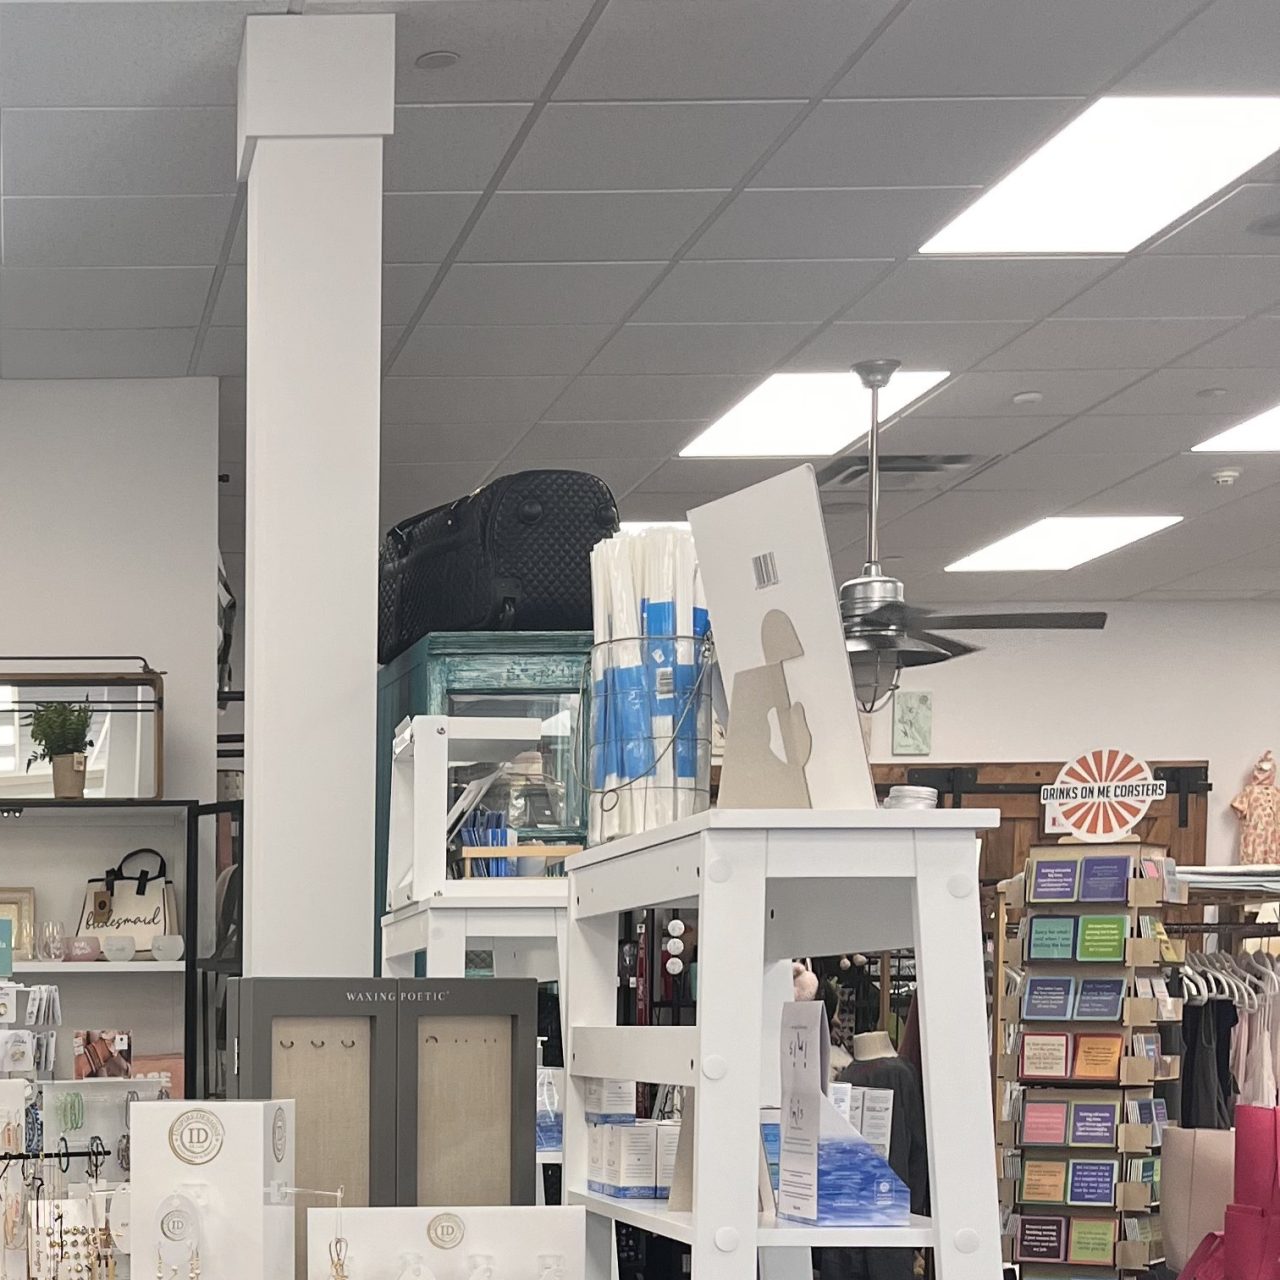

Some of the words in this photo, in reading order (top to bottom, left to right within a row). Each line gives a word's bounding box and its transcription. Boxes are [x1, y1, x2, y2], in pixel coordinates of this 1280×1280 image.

[1042, 786, 1078, 801] DRINKS
[1080, 786, 1095, 799] ON
[1097, 785, 1111, 798] ME
[1113, 783, 1165, 798] COASTERS
[346, 991, 396, 1002] WAXING
[400, 991, 446, 1001] POETIC
[187, 1127, 209, 1144] ID
